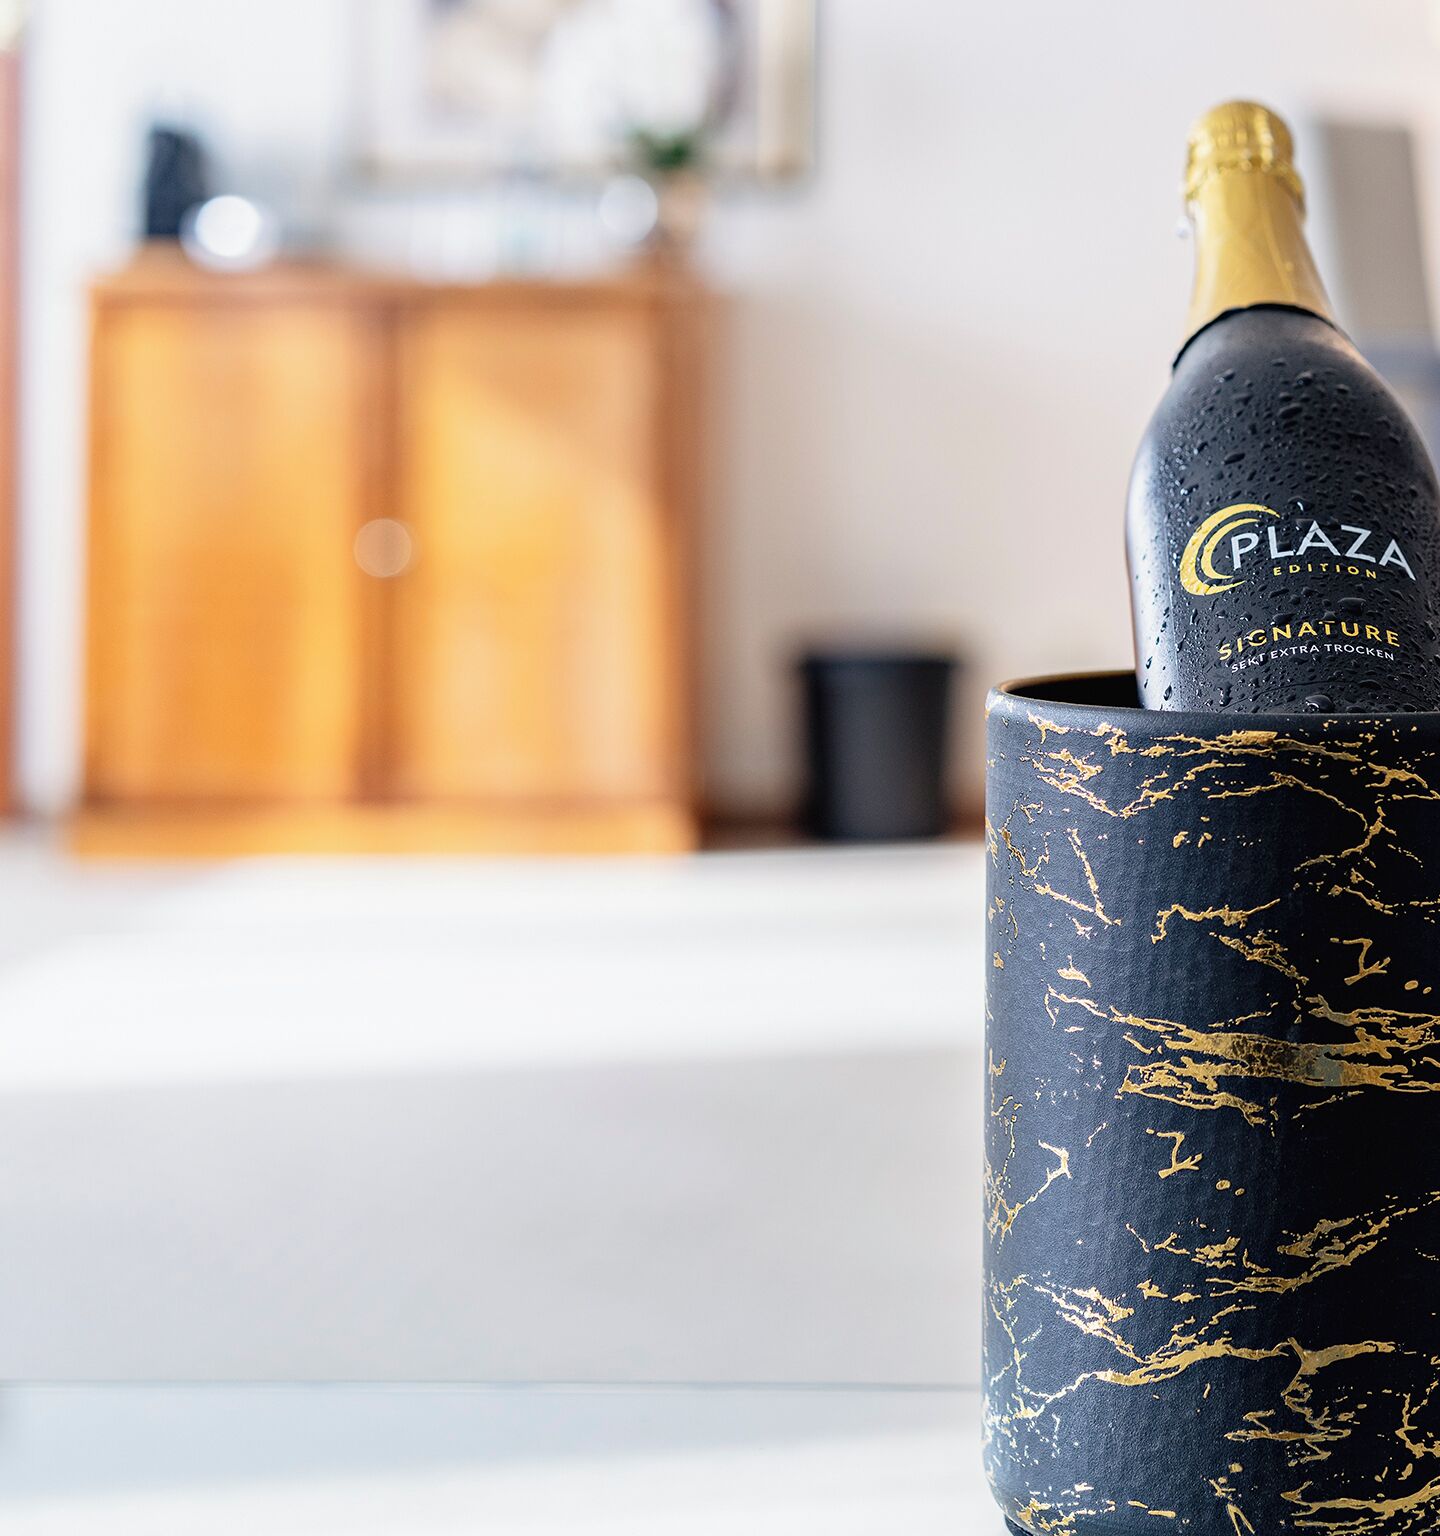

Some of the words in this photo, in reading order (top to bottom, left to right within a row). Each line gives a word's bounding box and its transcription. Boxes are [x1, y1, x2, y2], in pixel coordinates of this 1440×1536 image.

[1231, 520, 1416, 580] PLAZA
[1273, 563, 1377, 579] EDITION
[1219, 621, 1400, 661] SIGNATURE
[1231, 652, 1265, 673] SEKT
[1270, 644, 1319, 659] EXTRA
[1324, 643, 1394, 661] TROCKEN
